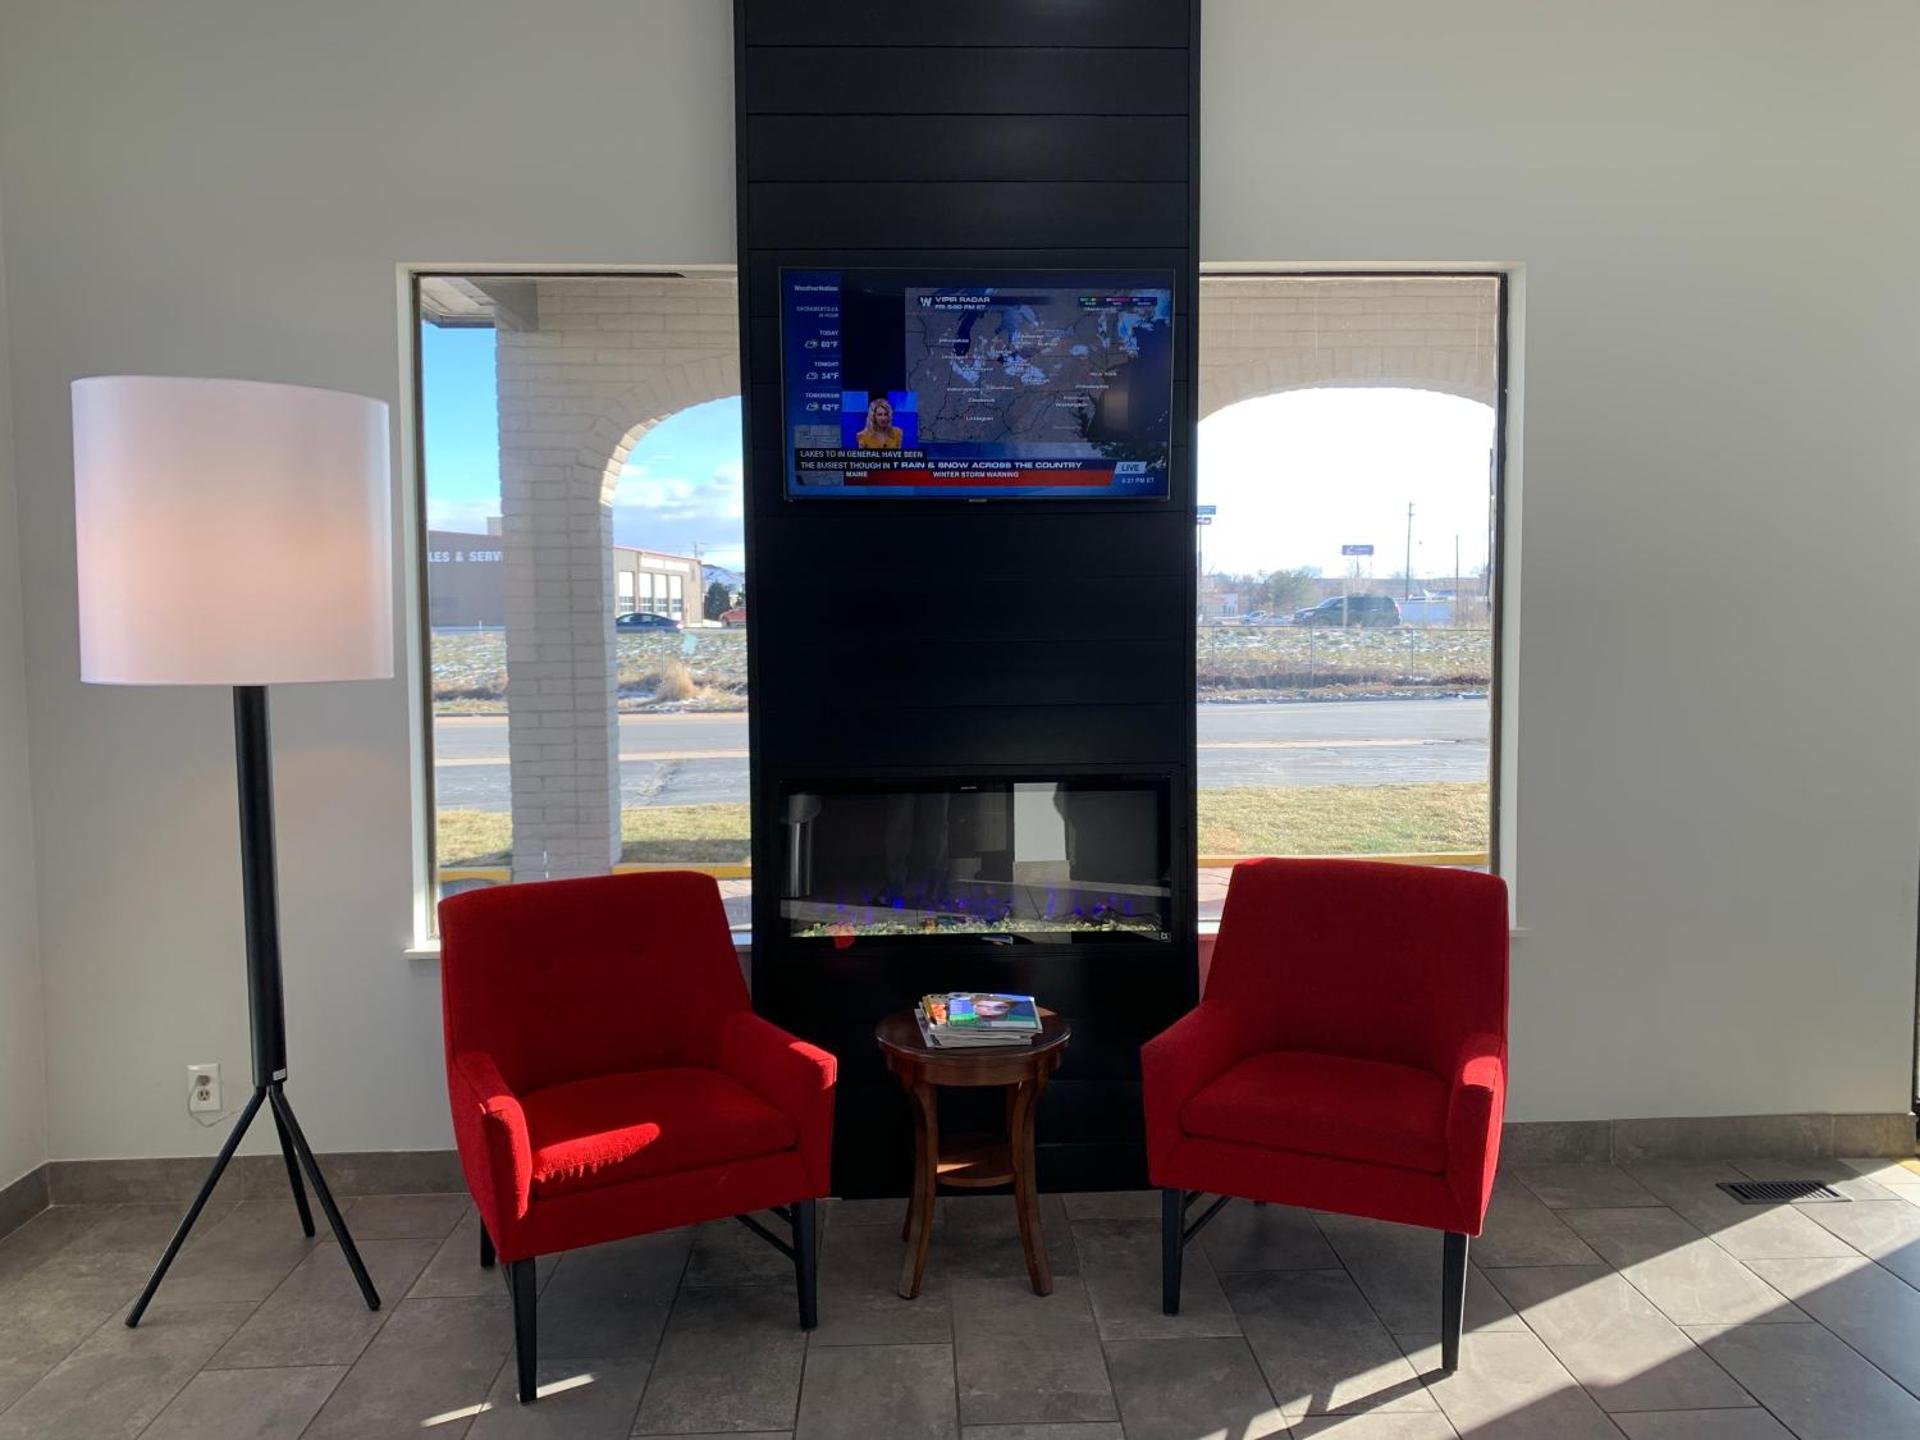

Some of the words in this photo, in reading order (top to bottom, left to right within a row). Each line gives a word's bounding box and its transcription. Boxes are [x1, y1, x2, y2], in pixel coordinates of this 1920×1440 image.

[800, 450, 824, 458] LAKES
[826, 450, 836, 458] TO
[837, 450, 845, 458] IN
[847, 450, 880, 458] GENERAL
[882, 450, 902, 458] HAVE
[903, 450, 923, 458] BEEN
[800, 461, 815, 469] THE
[816, 461, 848, 469] BUSIEST
[849, 461, 881, 469] THOUGH
[882, 461, 890, 469] IN
[901, 461, 925, 469] RAIN
[928, 461, 935, 469] &
[938, 461, 969, 469] SNOW
[972, 461, 1012, 469] ACROSS
[1014, 461, 1033, 469] THE
[1035, 461, 1082, 469] COUNTRY
[1121, 464, 1140, 472] LIVE
[845, 470, 868, 478] MAINE
